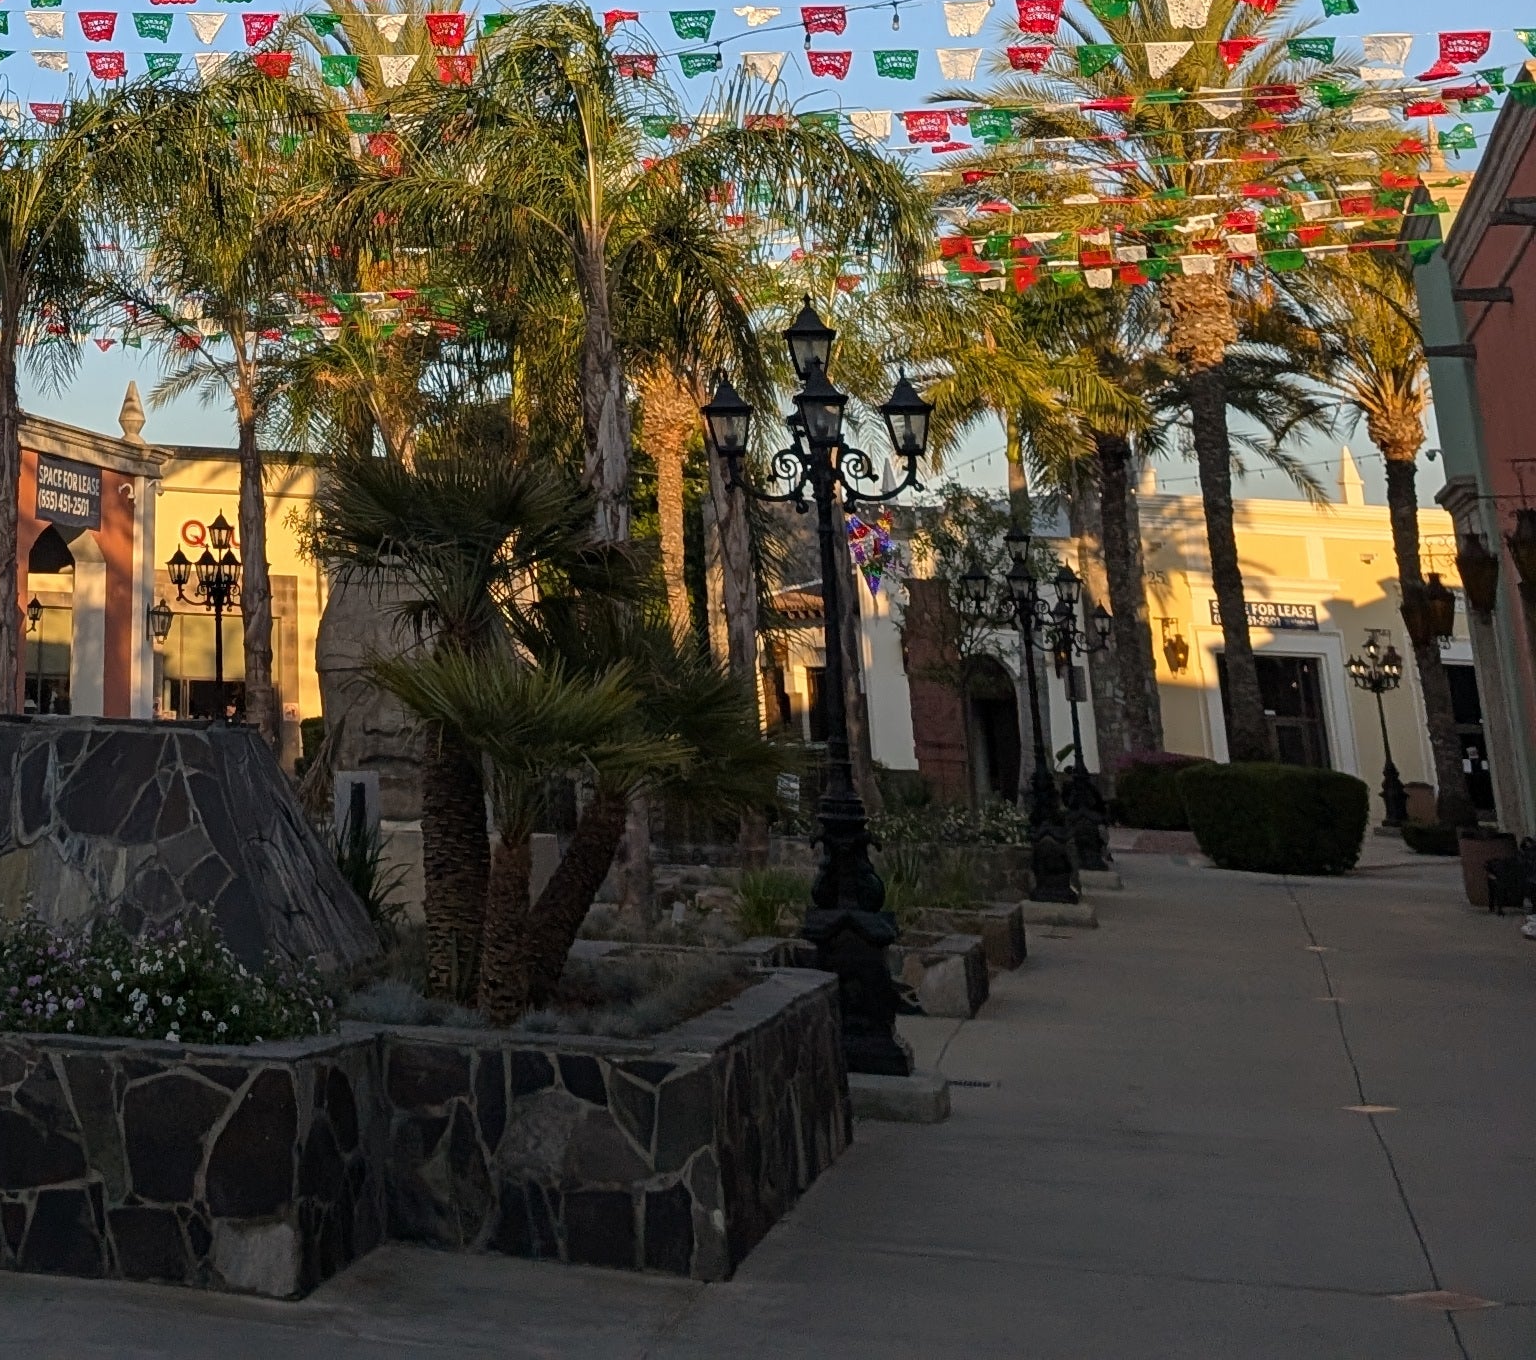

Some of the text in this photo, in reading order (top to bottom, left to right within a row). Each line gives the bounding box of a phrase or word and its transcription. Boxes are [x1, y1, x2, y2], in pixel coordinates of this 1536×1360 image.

[39, 464, 100, 497] SPACE FOR LEASE
[1250, 603, 1314, 619] FOR LEASE
[1246, 615, 1282, 627] 51-2501
